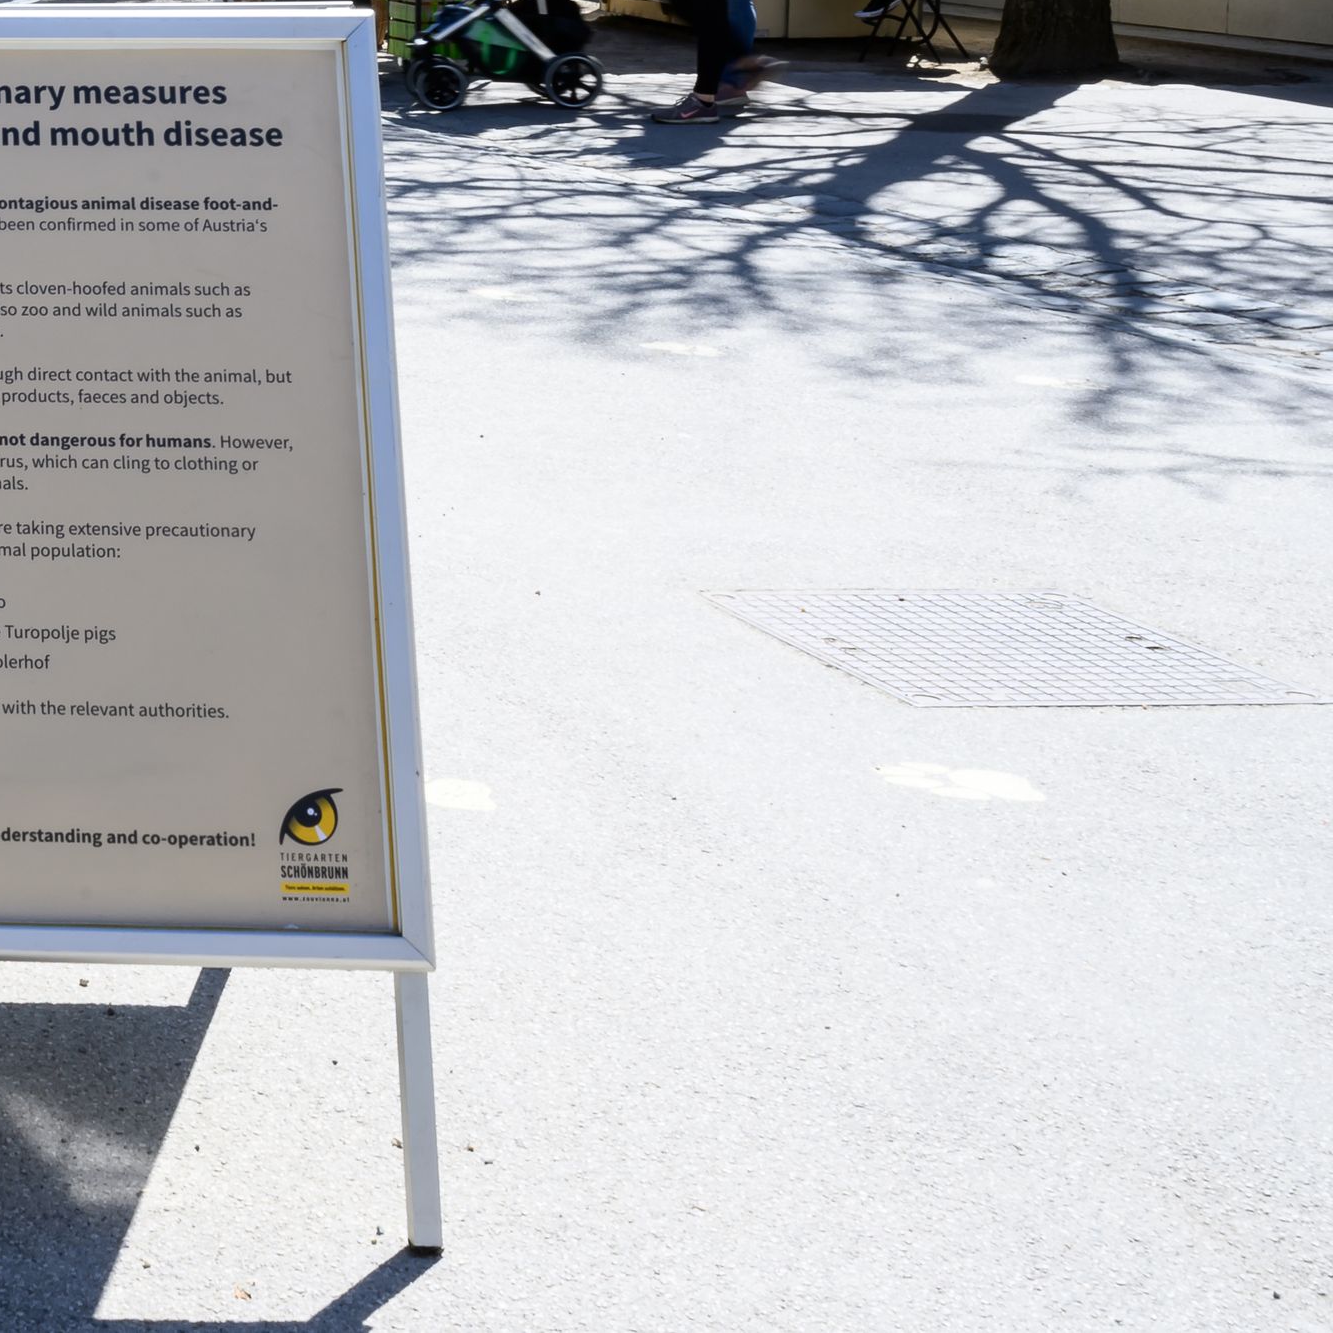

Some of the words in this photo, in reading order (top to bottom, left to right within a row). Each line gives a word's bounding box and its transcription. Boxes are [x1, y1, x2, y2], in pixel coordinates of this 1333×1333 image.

[72, 84, 227, 105] measures
[49, 120, 154, 146] mouth
[163, 119, 283, 147] disease
[80, 195, 136, 210] animal
[139, 196, 199, 210] disease
[202, 196, 278, 211] foot-and-
[38, 216, 116, 232] confirmed
[120, 217, 134, 231] in
[137, 220, 180, 232] some
[183, 217, 199, 232] of
[15, 279, 126, 295] cloven-hoofed
[129, 281, 191, 296] animals
[193, 281, 230, 296] such
[233, 285, 251, 296] as
[29, 431, 116, 450] dangerous
[118, 432, 143, 448] for
[145, 433, 215, 448] humans.
[219, 434, 293, 452] However,
[3, 624, 80, 644] Turopolje
[83, 625, 116, 644] pigs
[106, 829, 138, 844] and
[141, 830, 255, 849] co-operation!
[280, 852, 349, 863] TIERGARTEN
[280, 863, 349, 880] SCHÖNBRUNN
